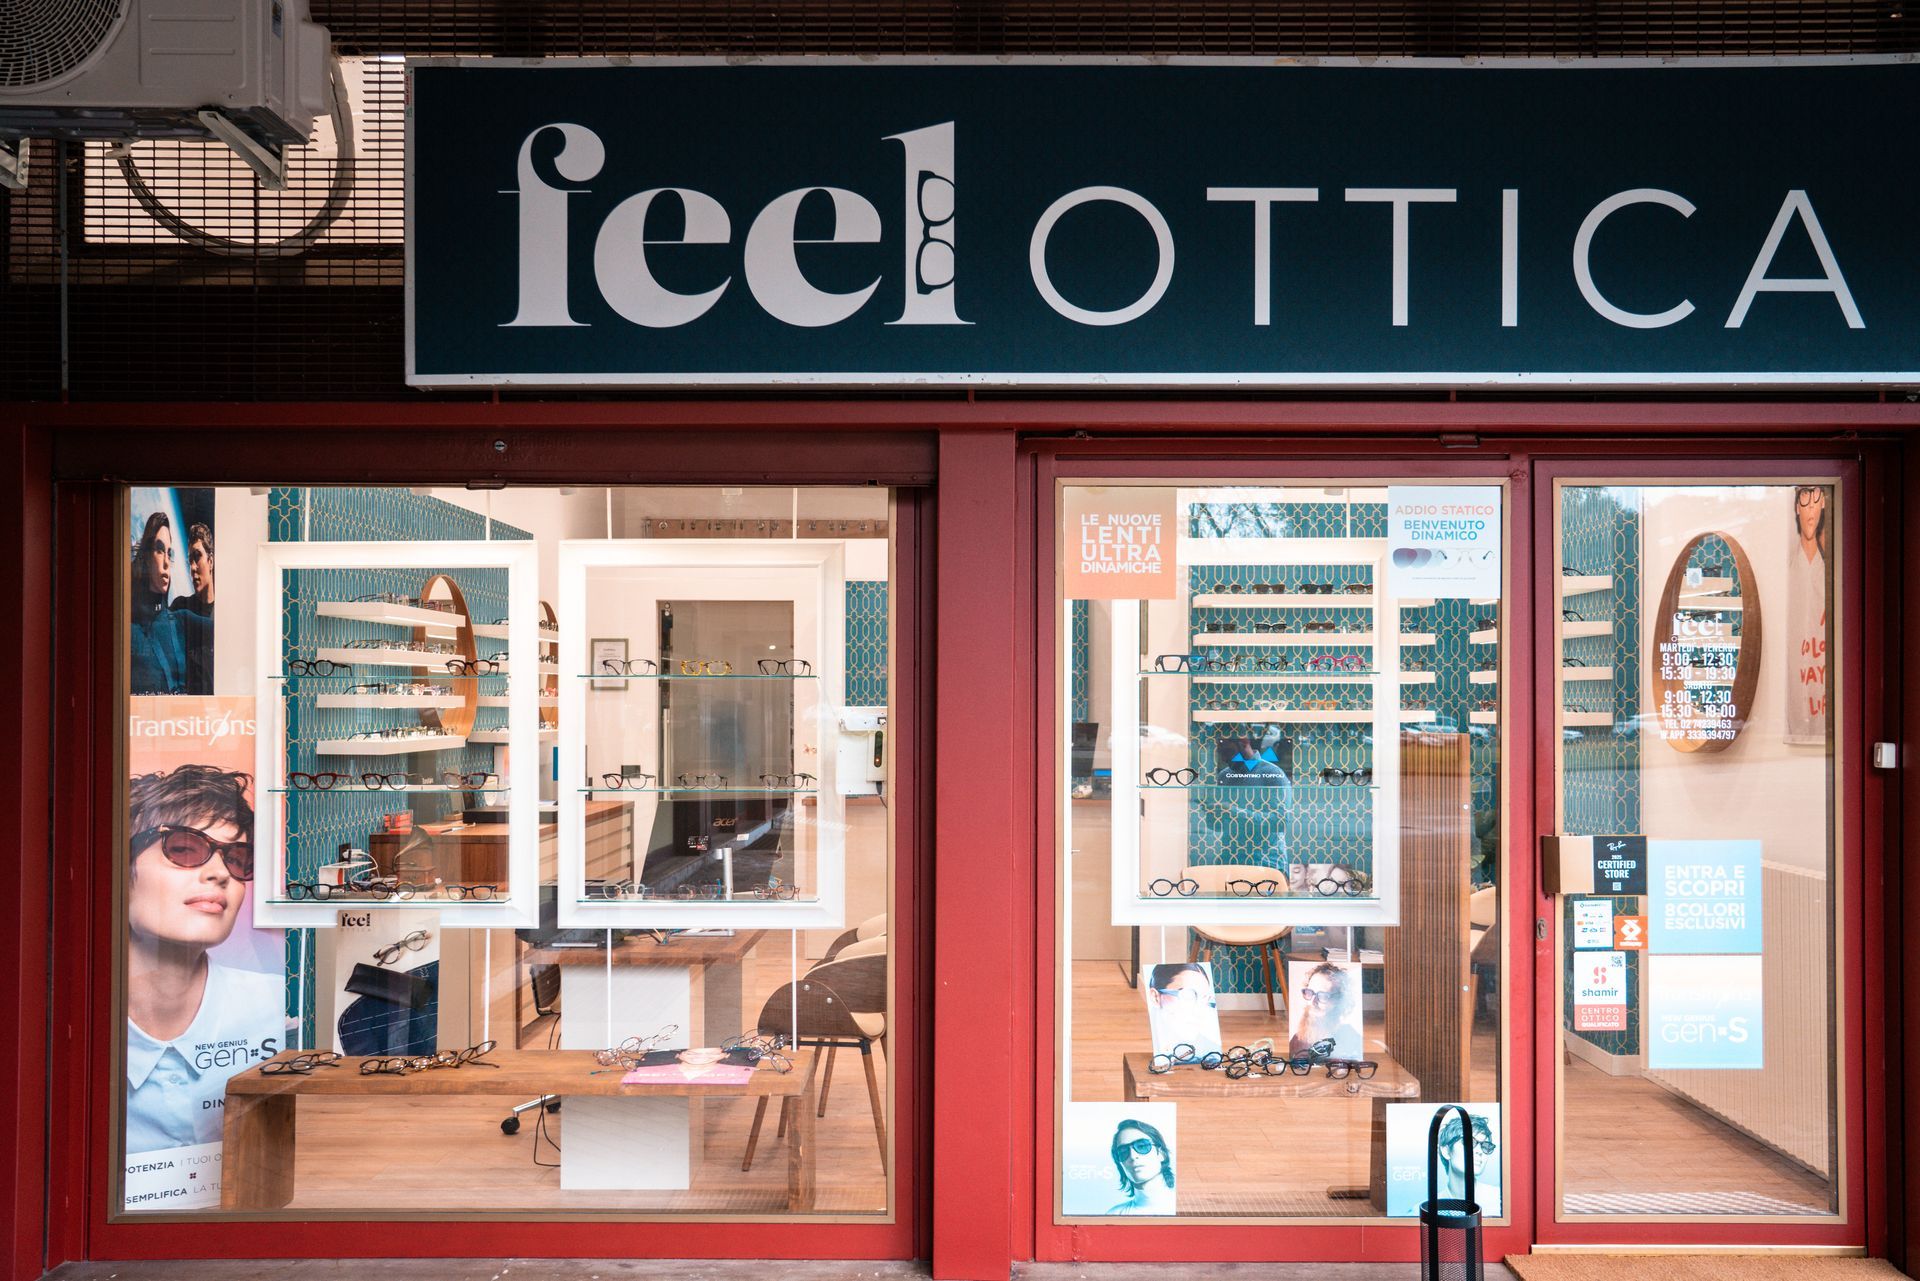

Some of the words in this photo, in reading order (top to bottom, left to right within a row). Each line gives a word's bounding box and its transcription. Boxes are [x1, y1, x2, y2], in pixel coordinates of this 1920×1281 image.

[498, 120, 976, 328] feel
[1029, 185, 1866, 329] OTTICA
[1395, 505, 1437, 516] ADDIO
[1442, 505, 1494, 516] STATICO
[1081, 514, 1099, 526] LE
[1108, 514, 1162, 526] NUOVE
[1404, 520, 1485, 530] BENVENUTO
[1082, 526, 1160, 544] LENTI
[1411, 531, 1478, 541] DINAMICO
[1082, 544, 1161, 561] ULTRA
[1081, 561, 1162, 574] DINAMICHE
[1663, 653, 1690, 666] 9:00
[1702, 653, 1733, 666] 12:30
[1660, 667, 1691, 680] 15:30
[1704, 667, 1736, 680] 19:30
[1700, 690, 1731, 704] 12:30
[1660, 704, 1691, 718] 15:30
[1704, 704, 1736, 718] 19:00
[1665, 719, 1678, 729] TEL
[1681, 719, 1691, 729] 02
[1597, 860, 1636, 869] CERTIFIED
[1604, 869, 1629, 879] STORE
[1664, 865, 1727, 880] ENTRA
[1734, 865, 1745, 879] E
[1664, 879, 1745, 897] SCOPRI
[341, 912, 371, 927] feel
[1664, 917, 1746, 930] ESCLUSIVI
[1582, 988, 1618, 997] shamir
[1581, 1007, 1619, 1015] CENTRO
[195, 1042, 216, 1051] NEW
[217, 1039, 248, 1049] GENIUS
[124, 1161, 175, 1174] OTENZIA
[187, 1155, 211, 1165] TUOI
[126, 1188, 187, 1204] SEMPLIFICA
[193, 1184, 207, 1194] LA
